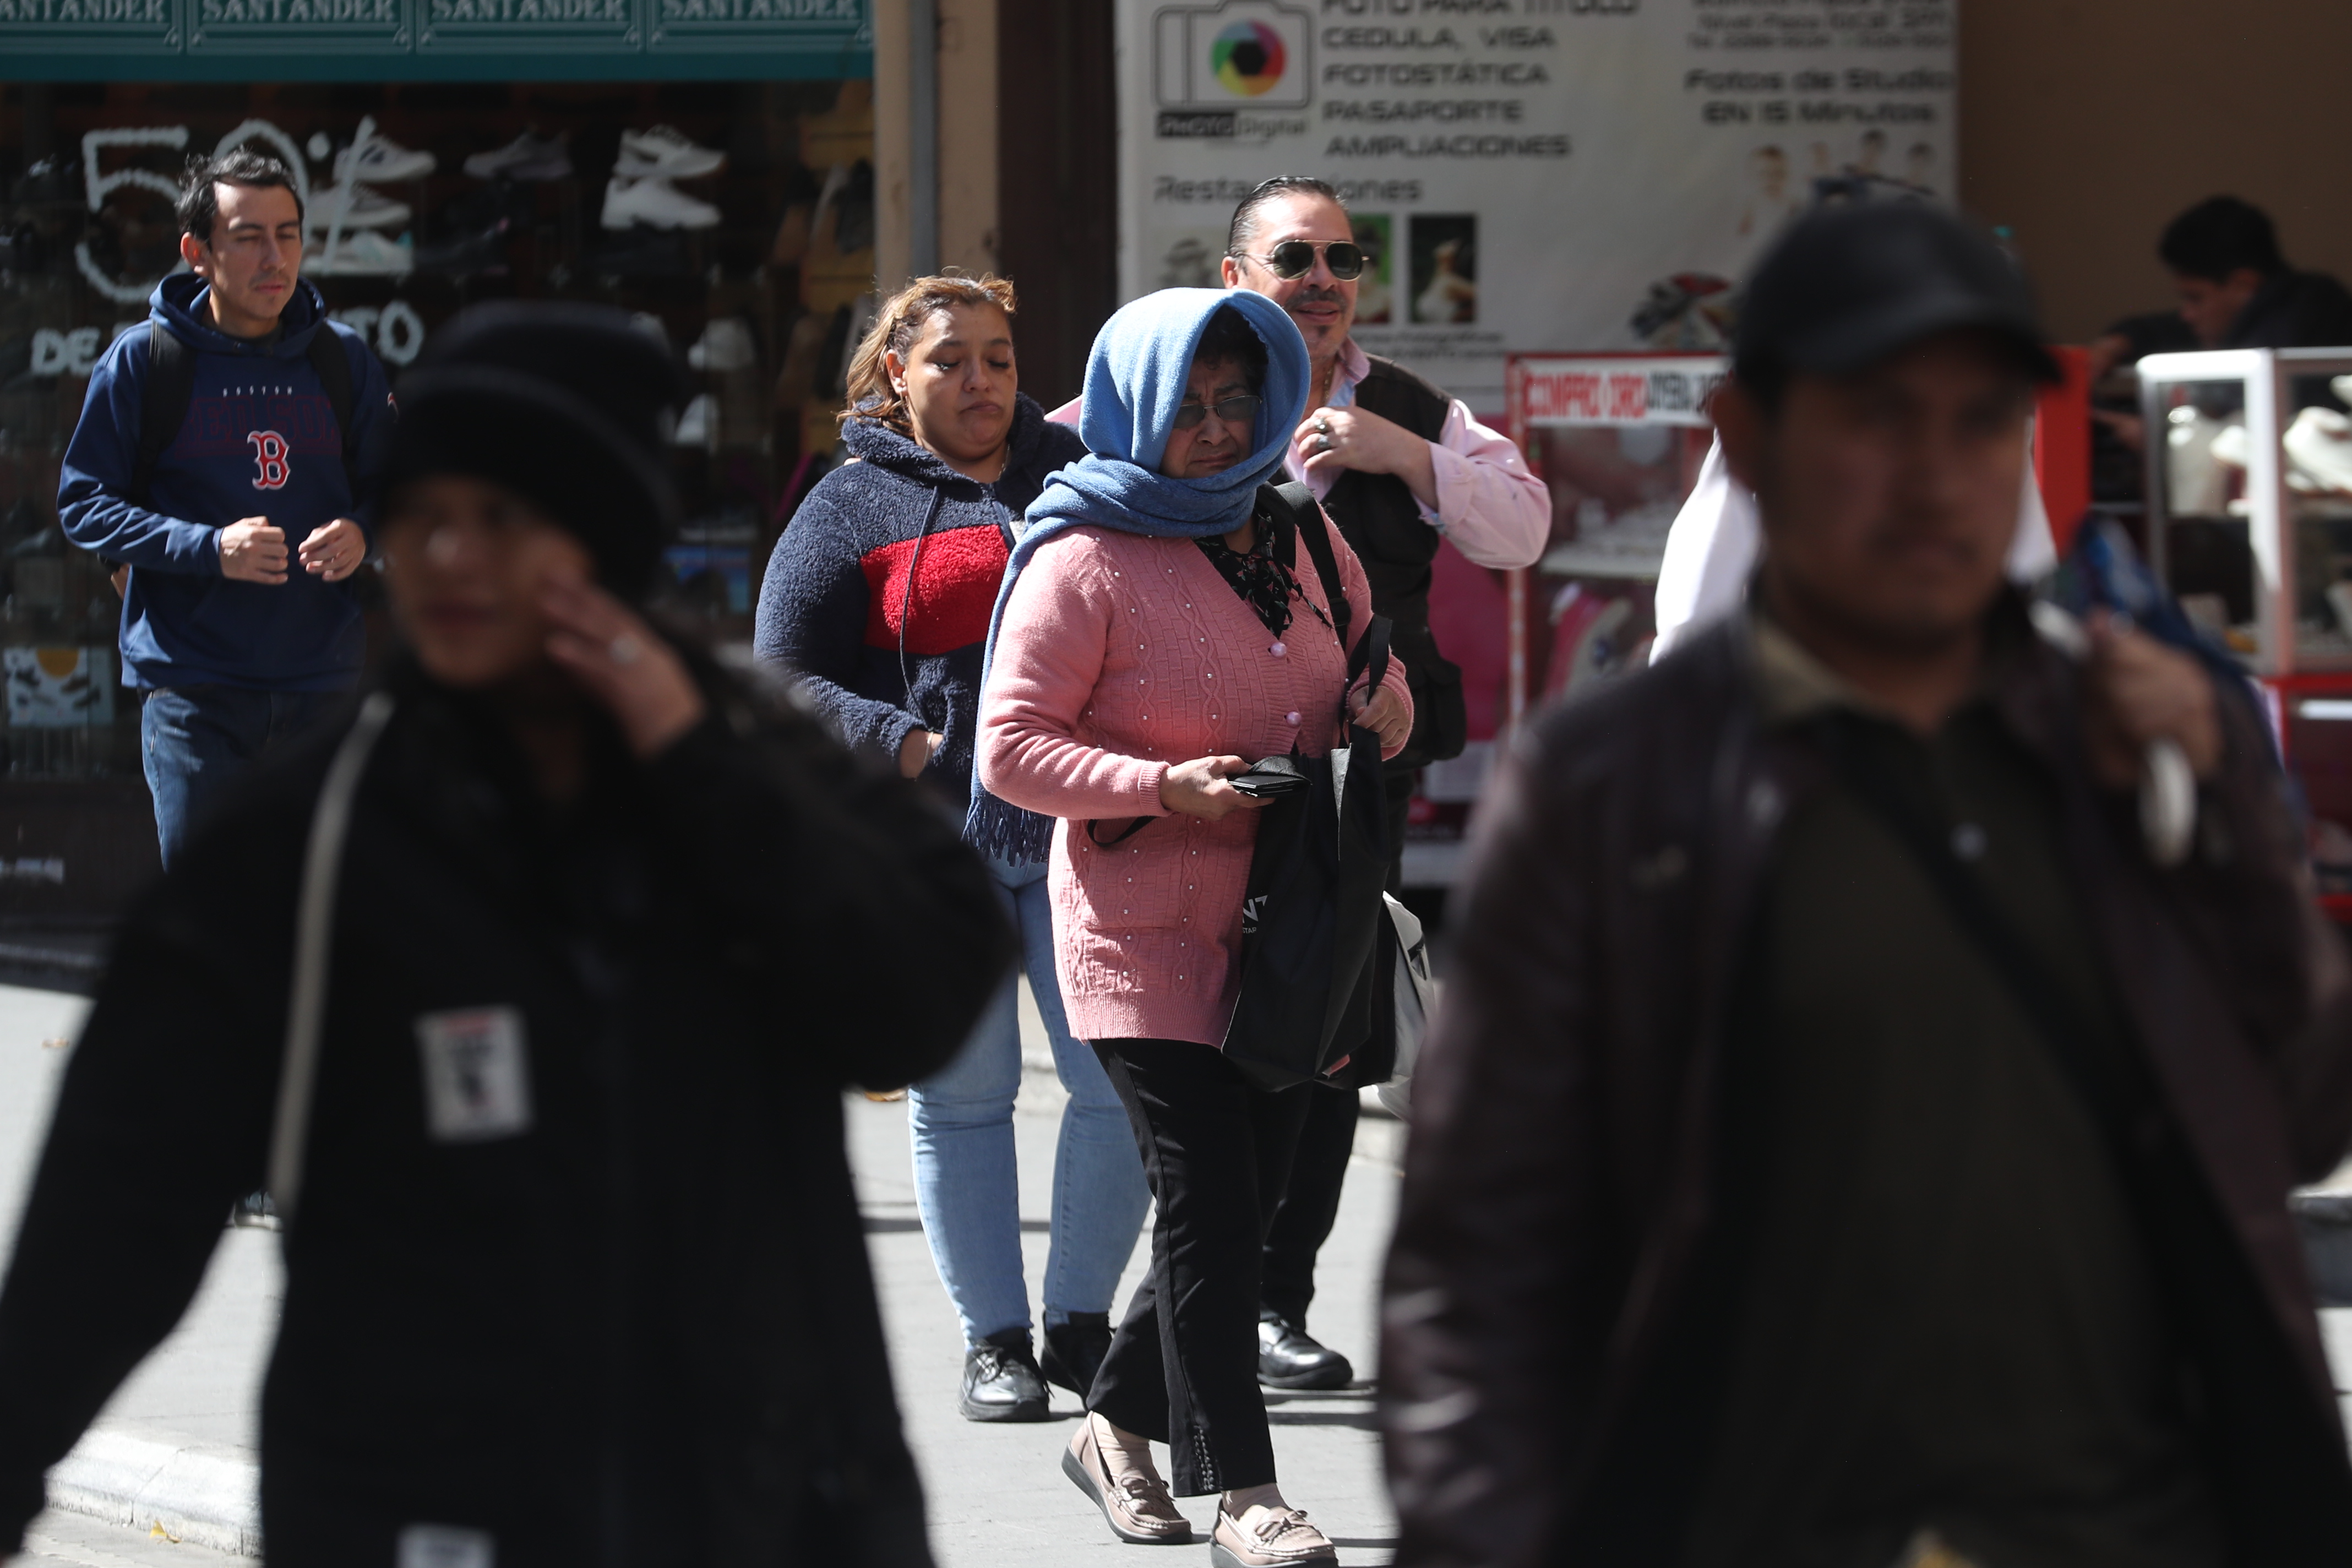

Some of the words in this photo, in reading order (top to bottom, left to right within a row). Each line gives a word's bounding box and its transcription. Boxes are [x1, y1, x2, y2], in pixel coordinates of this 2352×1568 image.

[202, 0, 395, 21] SANTANDER
[431, 0, 627, 21] SANTANDER
[661, 0, 859, 20] SANTANDER
[1321, 0, 1411, 15] FOTO
[1418, 0, 1513, 14] PARA
[1478, 26, 1556, 49] VISA
[1323, 58, 1549, 85] FOTOSTÁTICA
[1684, 67, 1784, 94] Fotos
[1791, 67, 1834, 92] de
[1844, 67, 1956, 92] Studio
[1323, 100, 1523, 123] PASAPORTE
[1798, 100, 1935, 124] Minutos
[1324, 134, 1572, 159] AMPLIACIONES
[1155, 174, 1423, 202] Restaones
[31, 326, 101, 379] DE
[222, 385, 293, 398] BOSTON
[247, 430, 291, 490] B
